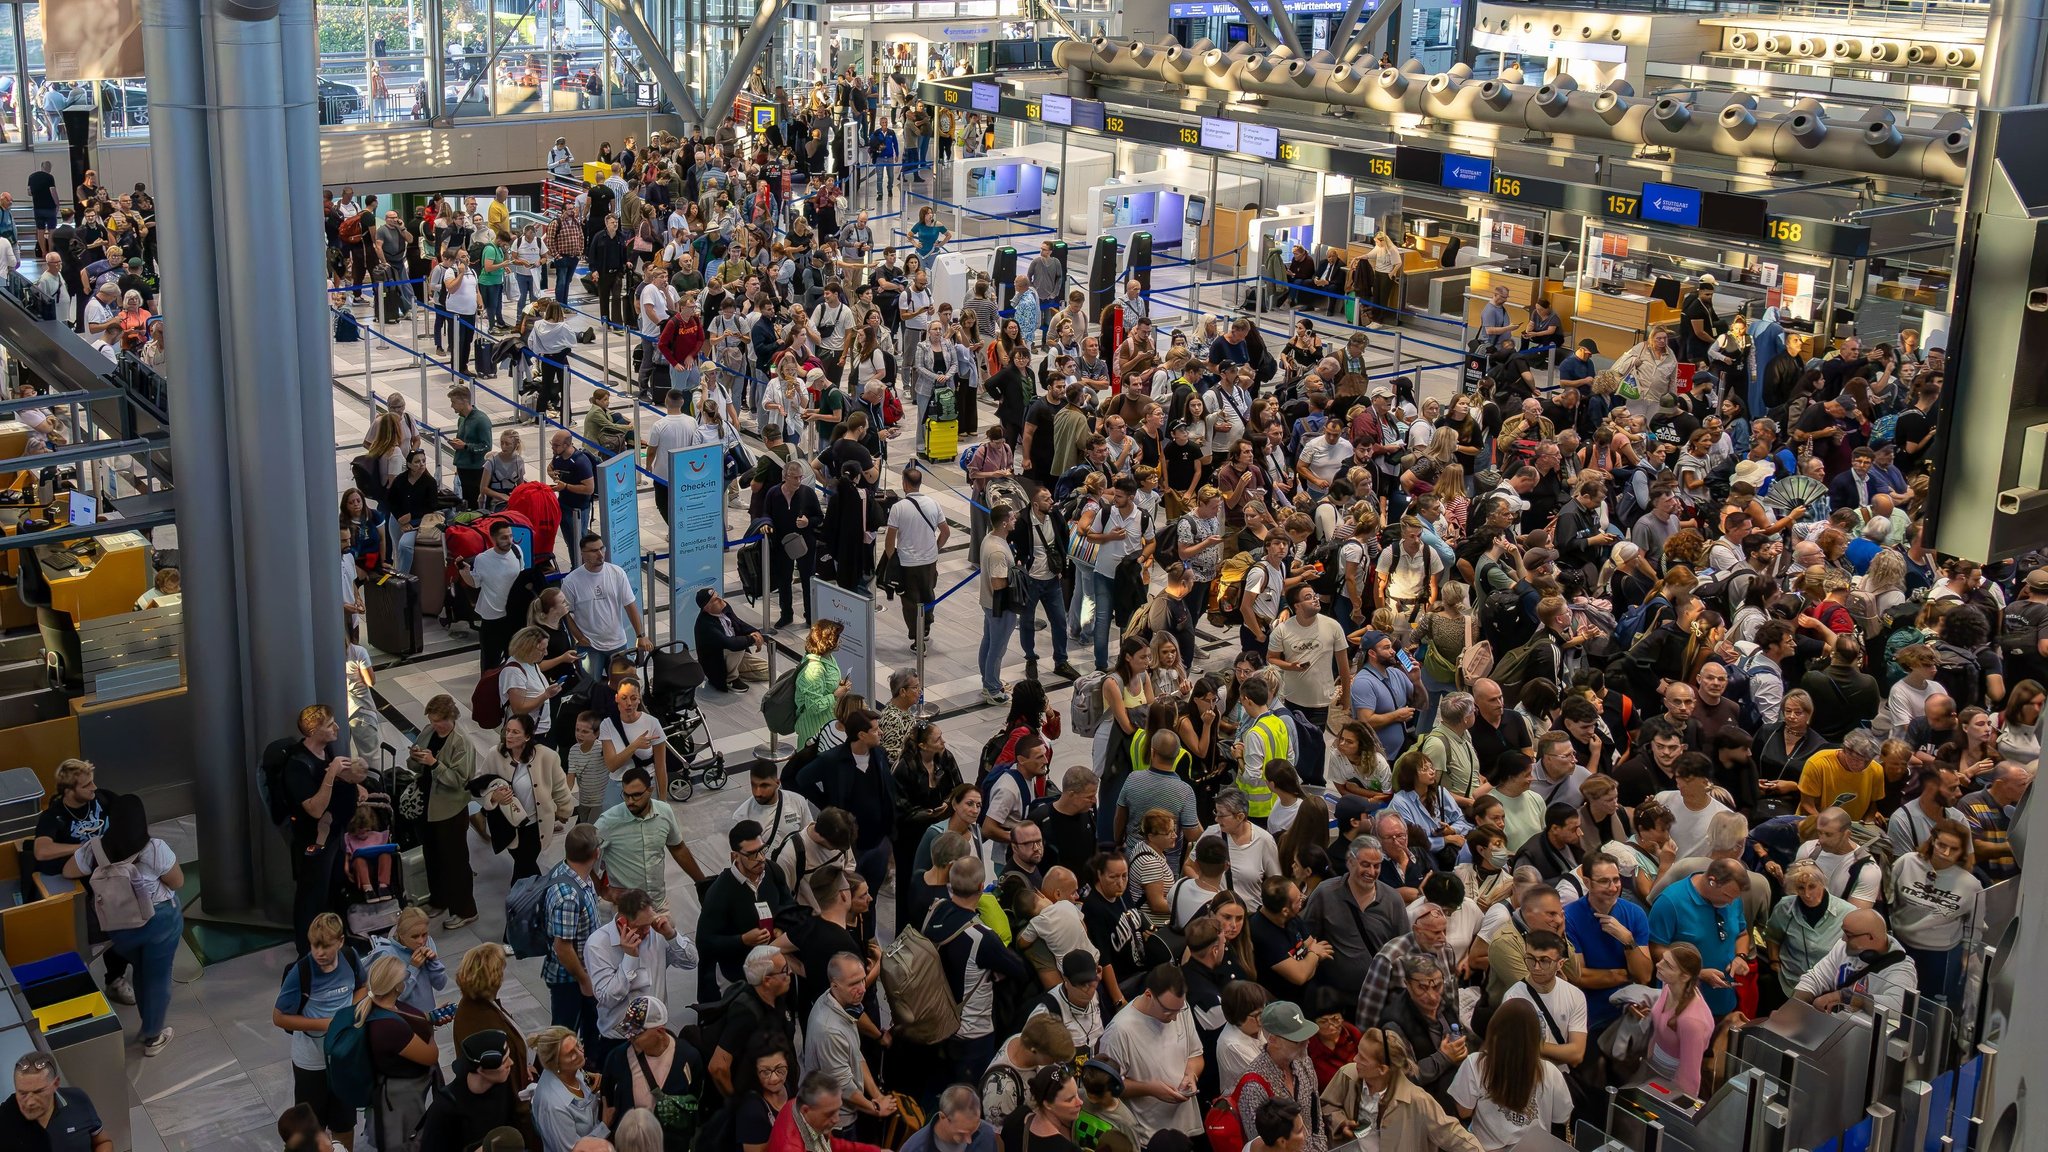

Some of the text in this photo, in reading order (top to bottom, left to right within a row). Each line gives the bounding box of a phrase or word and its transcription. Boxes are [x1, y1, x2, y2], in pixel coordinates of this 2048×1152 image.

[944, 90, 958, 104] 150
[1026, 104, 1040, 118] 151
[1106, 117, 1124, 132] 152
[1179, 128, 1198, 144] 153
[1280, 144, 1300, 160] 154
[1369, 158, 1392, 176] 155
[1494, 178, 1521, 197] 156
[1607, 195, 1637, 215] 157
[1661, 205, 1682, 213] AIRPORT
[1662, 199, 1689, 209] STUTTGART
[1768, 220, 1802, 242] 158
[680, 480, 716, 493] Check-in
[611, 490, 633, 506] Bag Drop
[1902, 886, 1960, 910] monica
